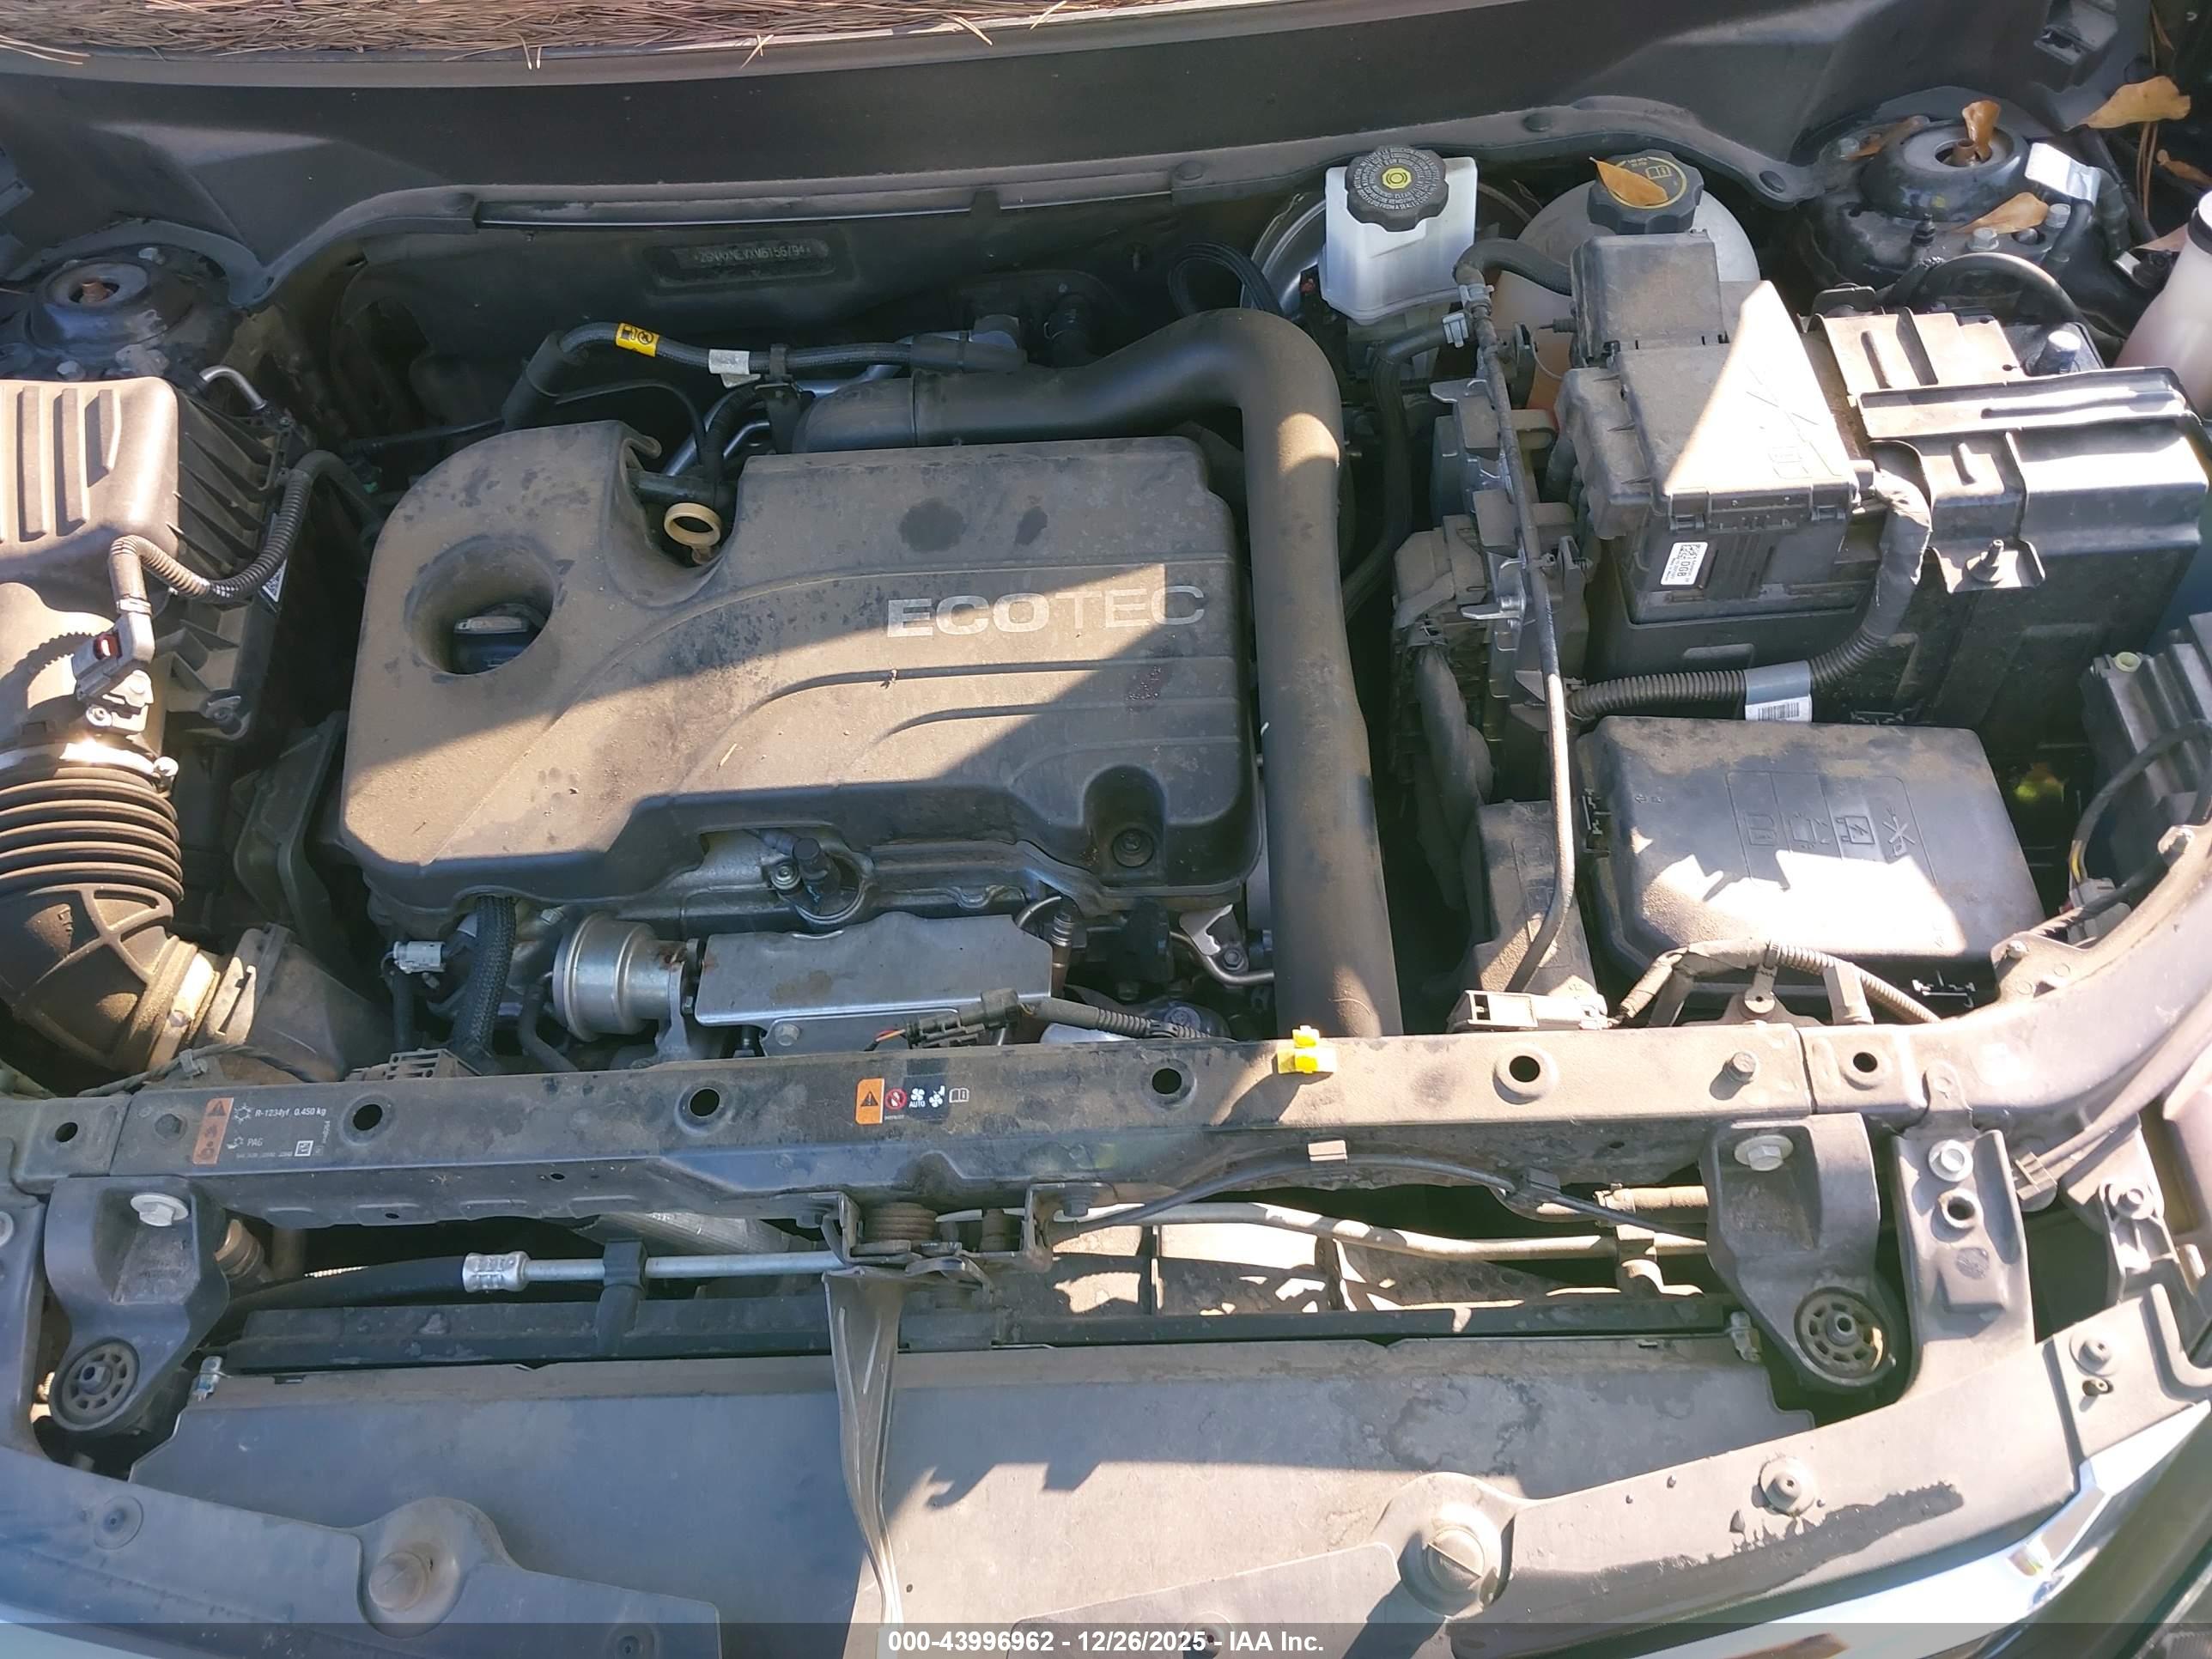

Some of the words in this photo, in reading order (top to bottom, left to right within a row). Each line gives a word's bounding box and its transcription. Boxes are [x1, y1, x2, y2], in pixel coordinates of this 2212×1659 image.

[887, 585, 1204, 637] ECOTEC
[316, 1107, 326, 1116] kg
[246, 1138, 264, 1146] PAG
